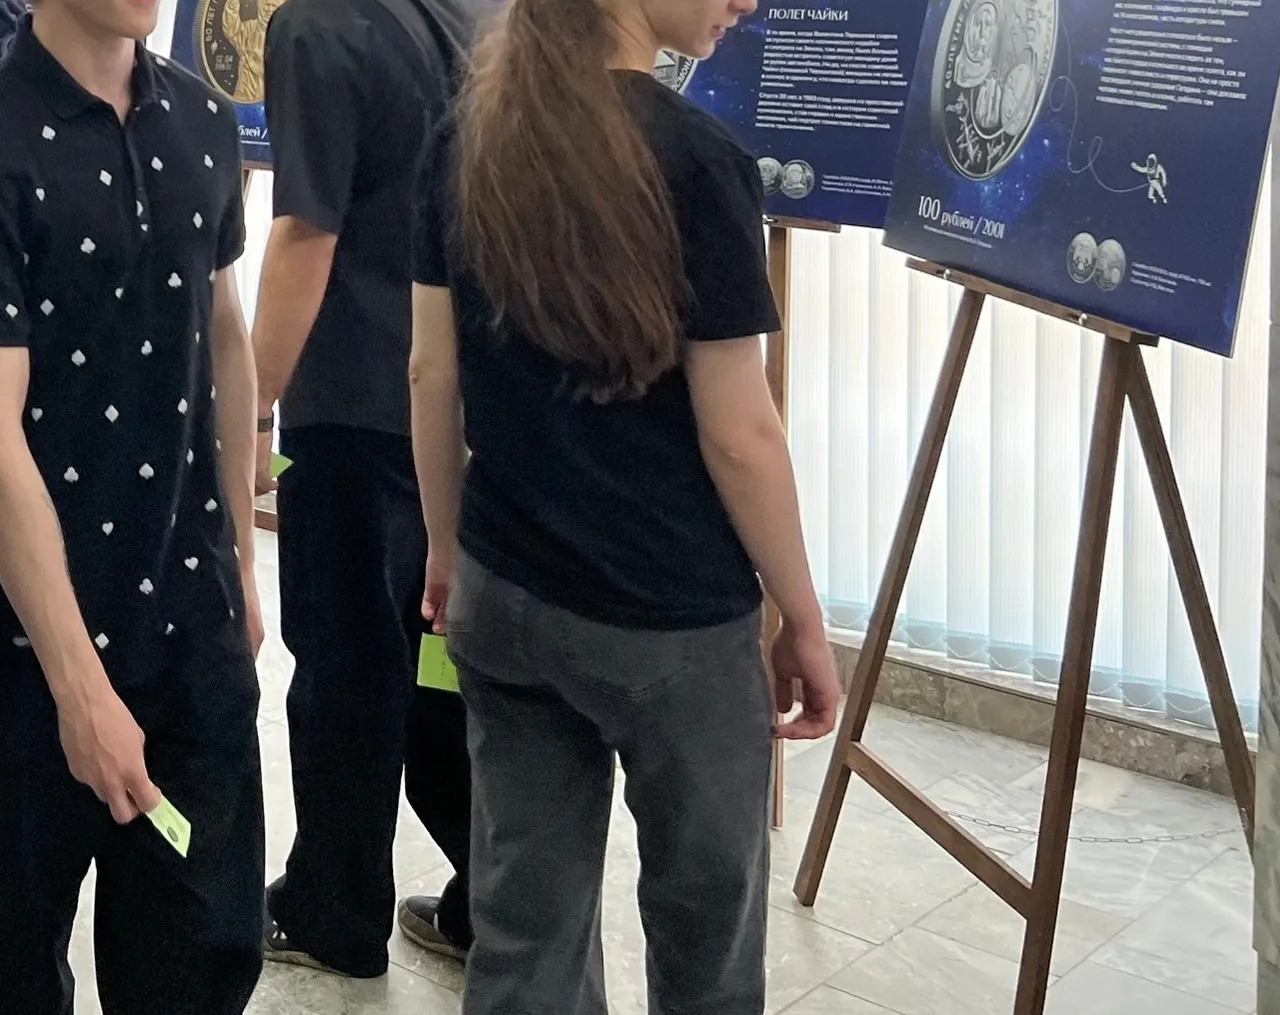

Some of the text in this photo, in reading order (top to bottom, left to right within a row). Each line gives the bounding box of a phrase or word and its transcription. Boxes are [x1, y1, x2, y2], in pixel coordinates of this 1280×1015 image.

[768, 6, 849, 21] ПОЛЕТ ЧАЙКИ
[918, 196, 940, 220] 100
[941, 211, 975, 230] рублей
[981, 218, 1005, 239] 2001
